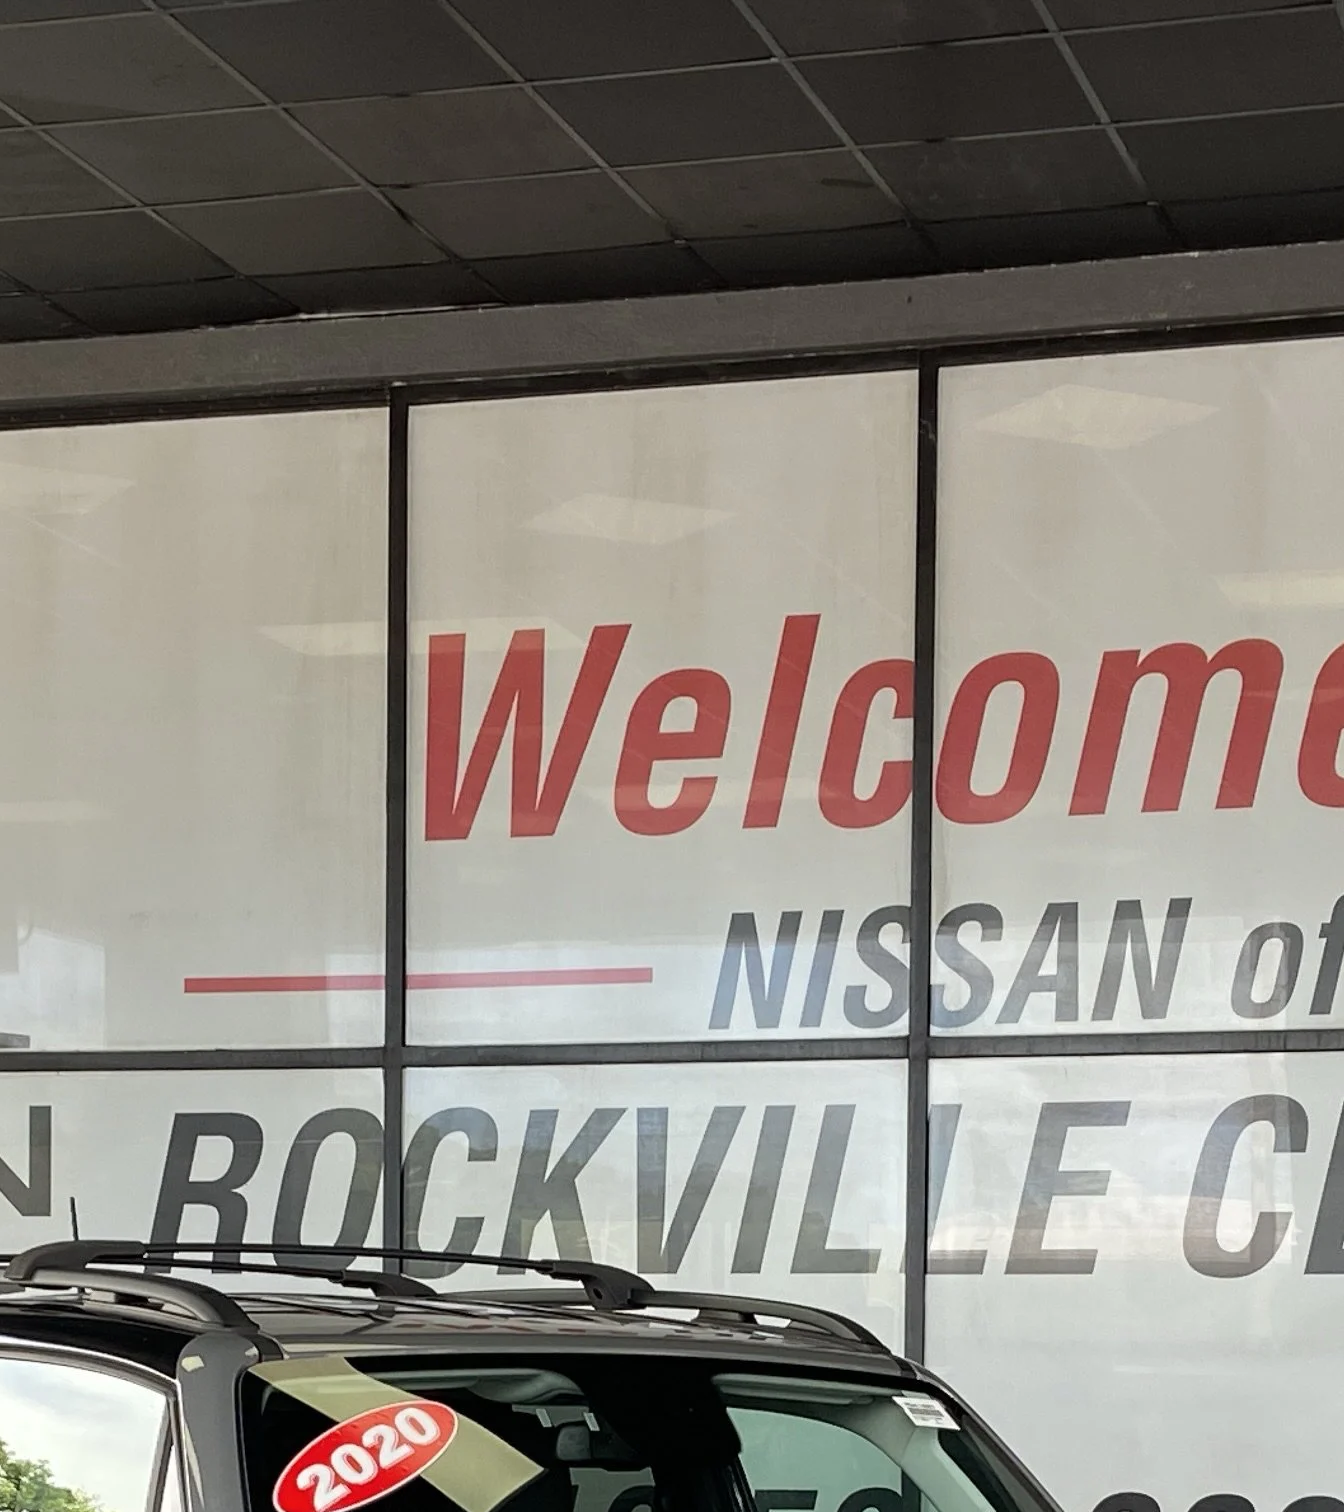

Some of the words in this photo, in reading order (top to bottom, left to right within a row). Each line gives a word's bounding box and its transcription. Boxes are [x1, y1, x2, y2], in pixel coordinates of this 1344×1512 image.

[708, 896, 1193, 1031] NISSAN
[144, 1101, 1132, 1280] ROCKVILLE
[296, 1407, 441, 1512] 2020
